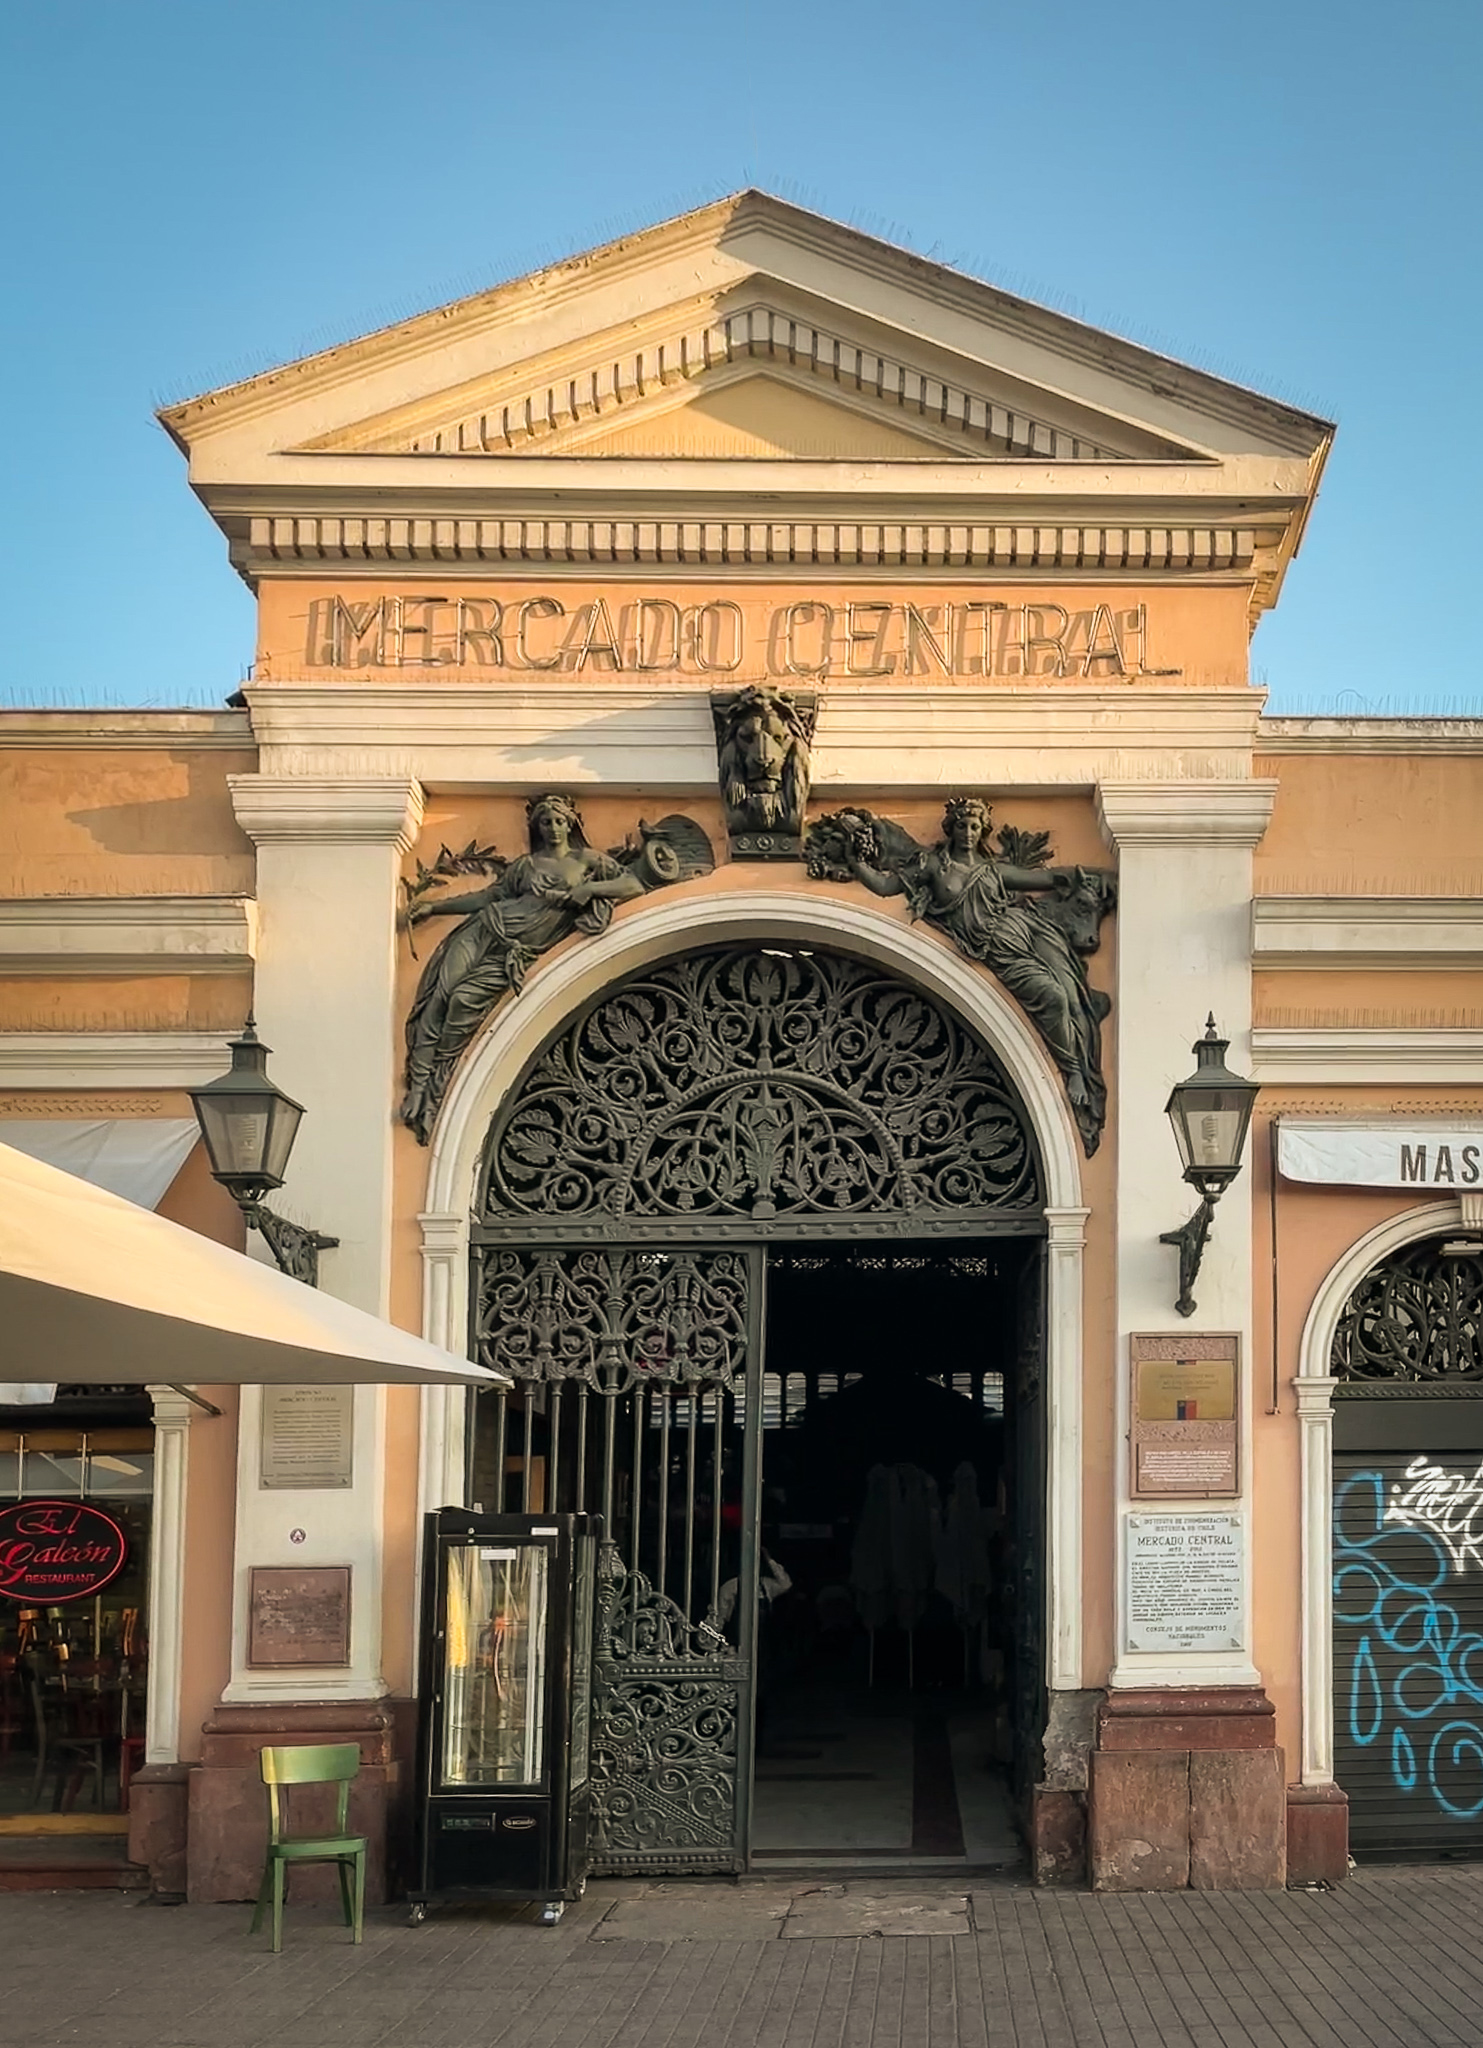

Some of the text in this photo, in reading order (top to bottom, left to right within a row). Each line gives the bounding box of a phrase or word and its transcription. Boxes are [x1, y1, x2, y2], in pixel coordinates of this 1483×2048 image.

[330, 595, 1182, 677] MERCADO CENTRAL
[1400, 1144, 1480, 1183] MAS
[16, 1509, 82, 1535] El
[1137, 1535, 1233, 1546] MERCADO CENTRAL
[0, 1538, 111, 1584] Galeón
[25, 1573, 95, 1583] RESTAURANT
